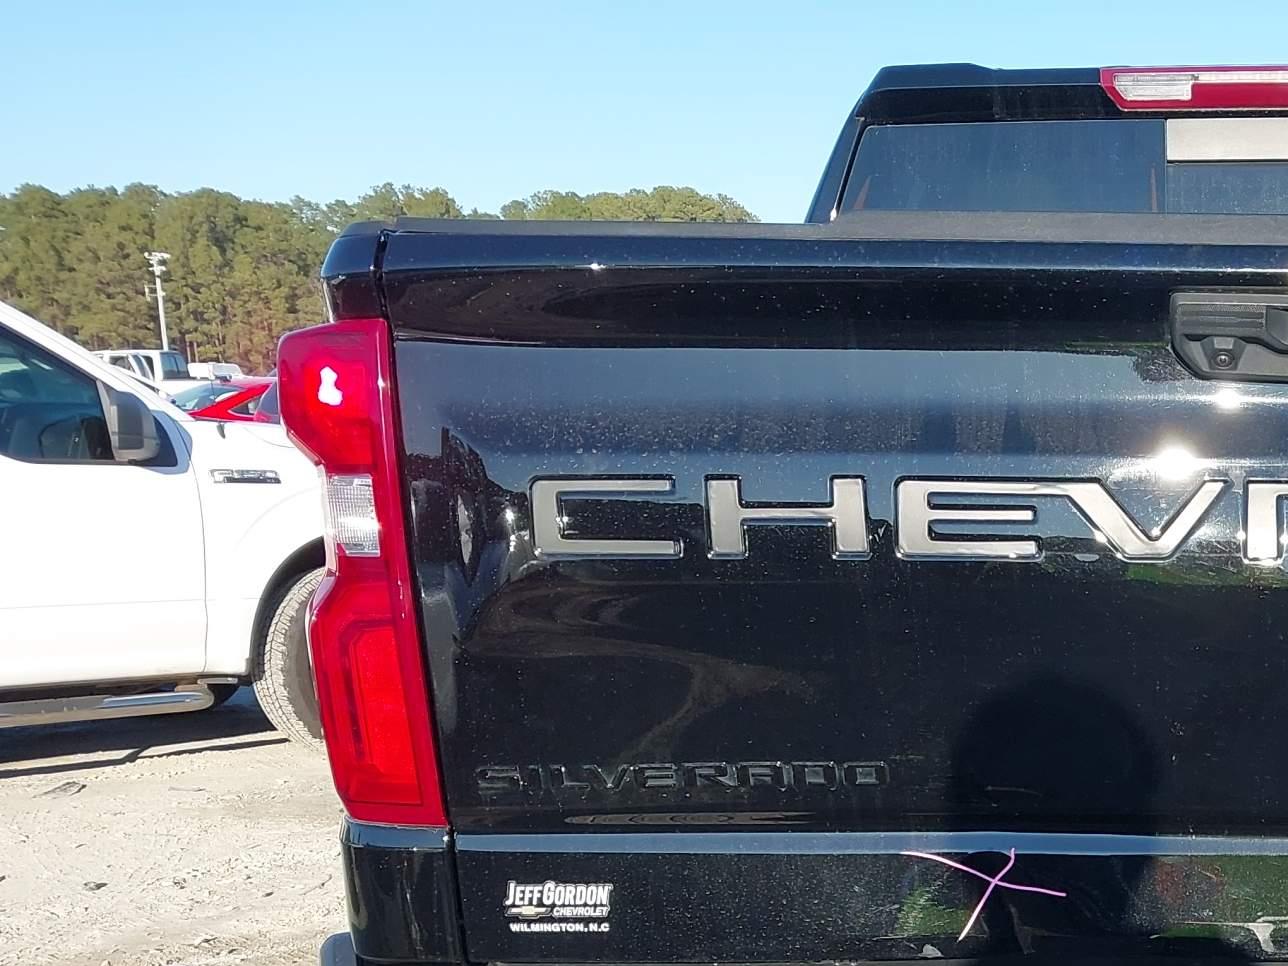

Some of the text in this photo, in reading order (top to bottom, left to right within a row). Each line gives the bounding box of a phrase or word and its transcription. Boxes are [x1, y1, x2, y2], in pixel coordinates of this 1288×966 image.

[477, 761, 891, 793] SILVERADO
[504, 881, 610, 906] JEFF GORDON
[553, 906, 609, 917] CHEVROLET
